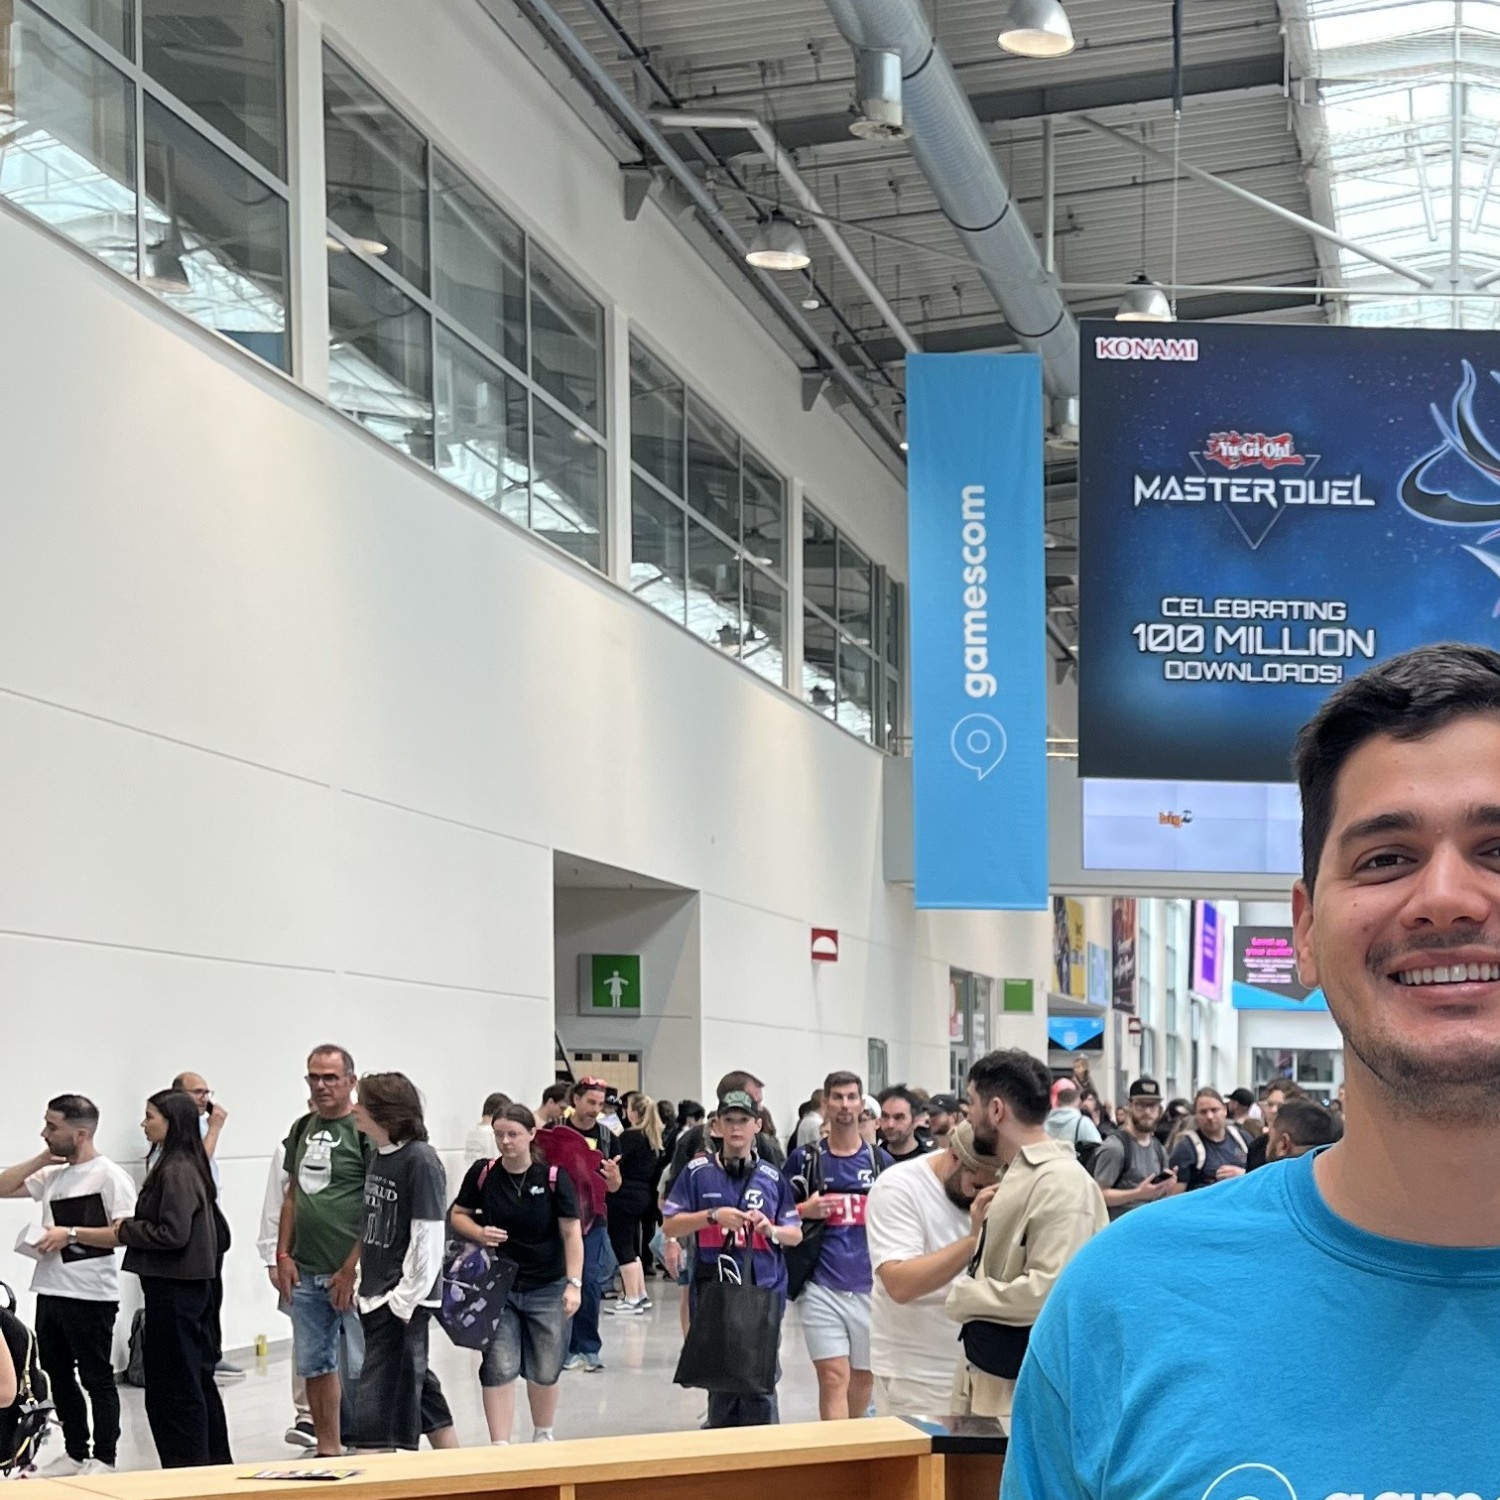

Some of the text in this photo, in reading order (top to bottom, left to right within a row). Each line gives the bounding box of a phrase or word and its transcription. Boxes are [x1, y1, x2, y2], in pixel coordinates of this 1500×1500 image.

[1095, 337, 1199, 361] KONAMI
[1134, 474, 1376, 508] MASTER DUEL
[961, 484, 997, 698] gamescom
[1162, 597, 1346, 621] CELEBRATING
[1132, 623, 1376, 658] 100 MILLION
[1164, 660, 1343, 684] DOWNLOADS!
